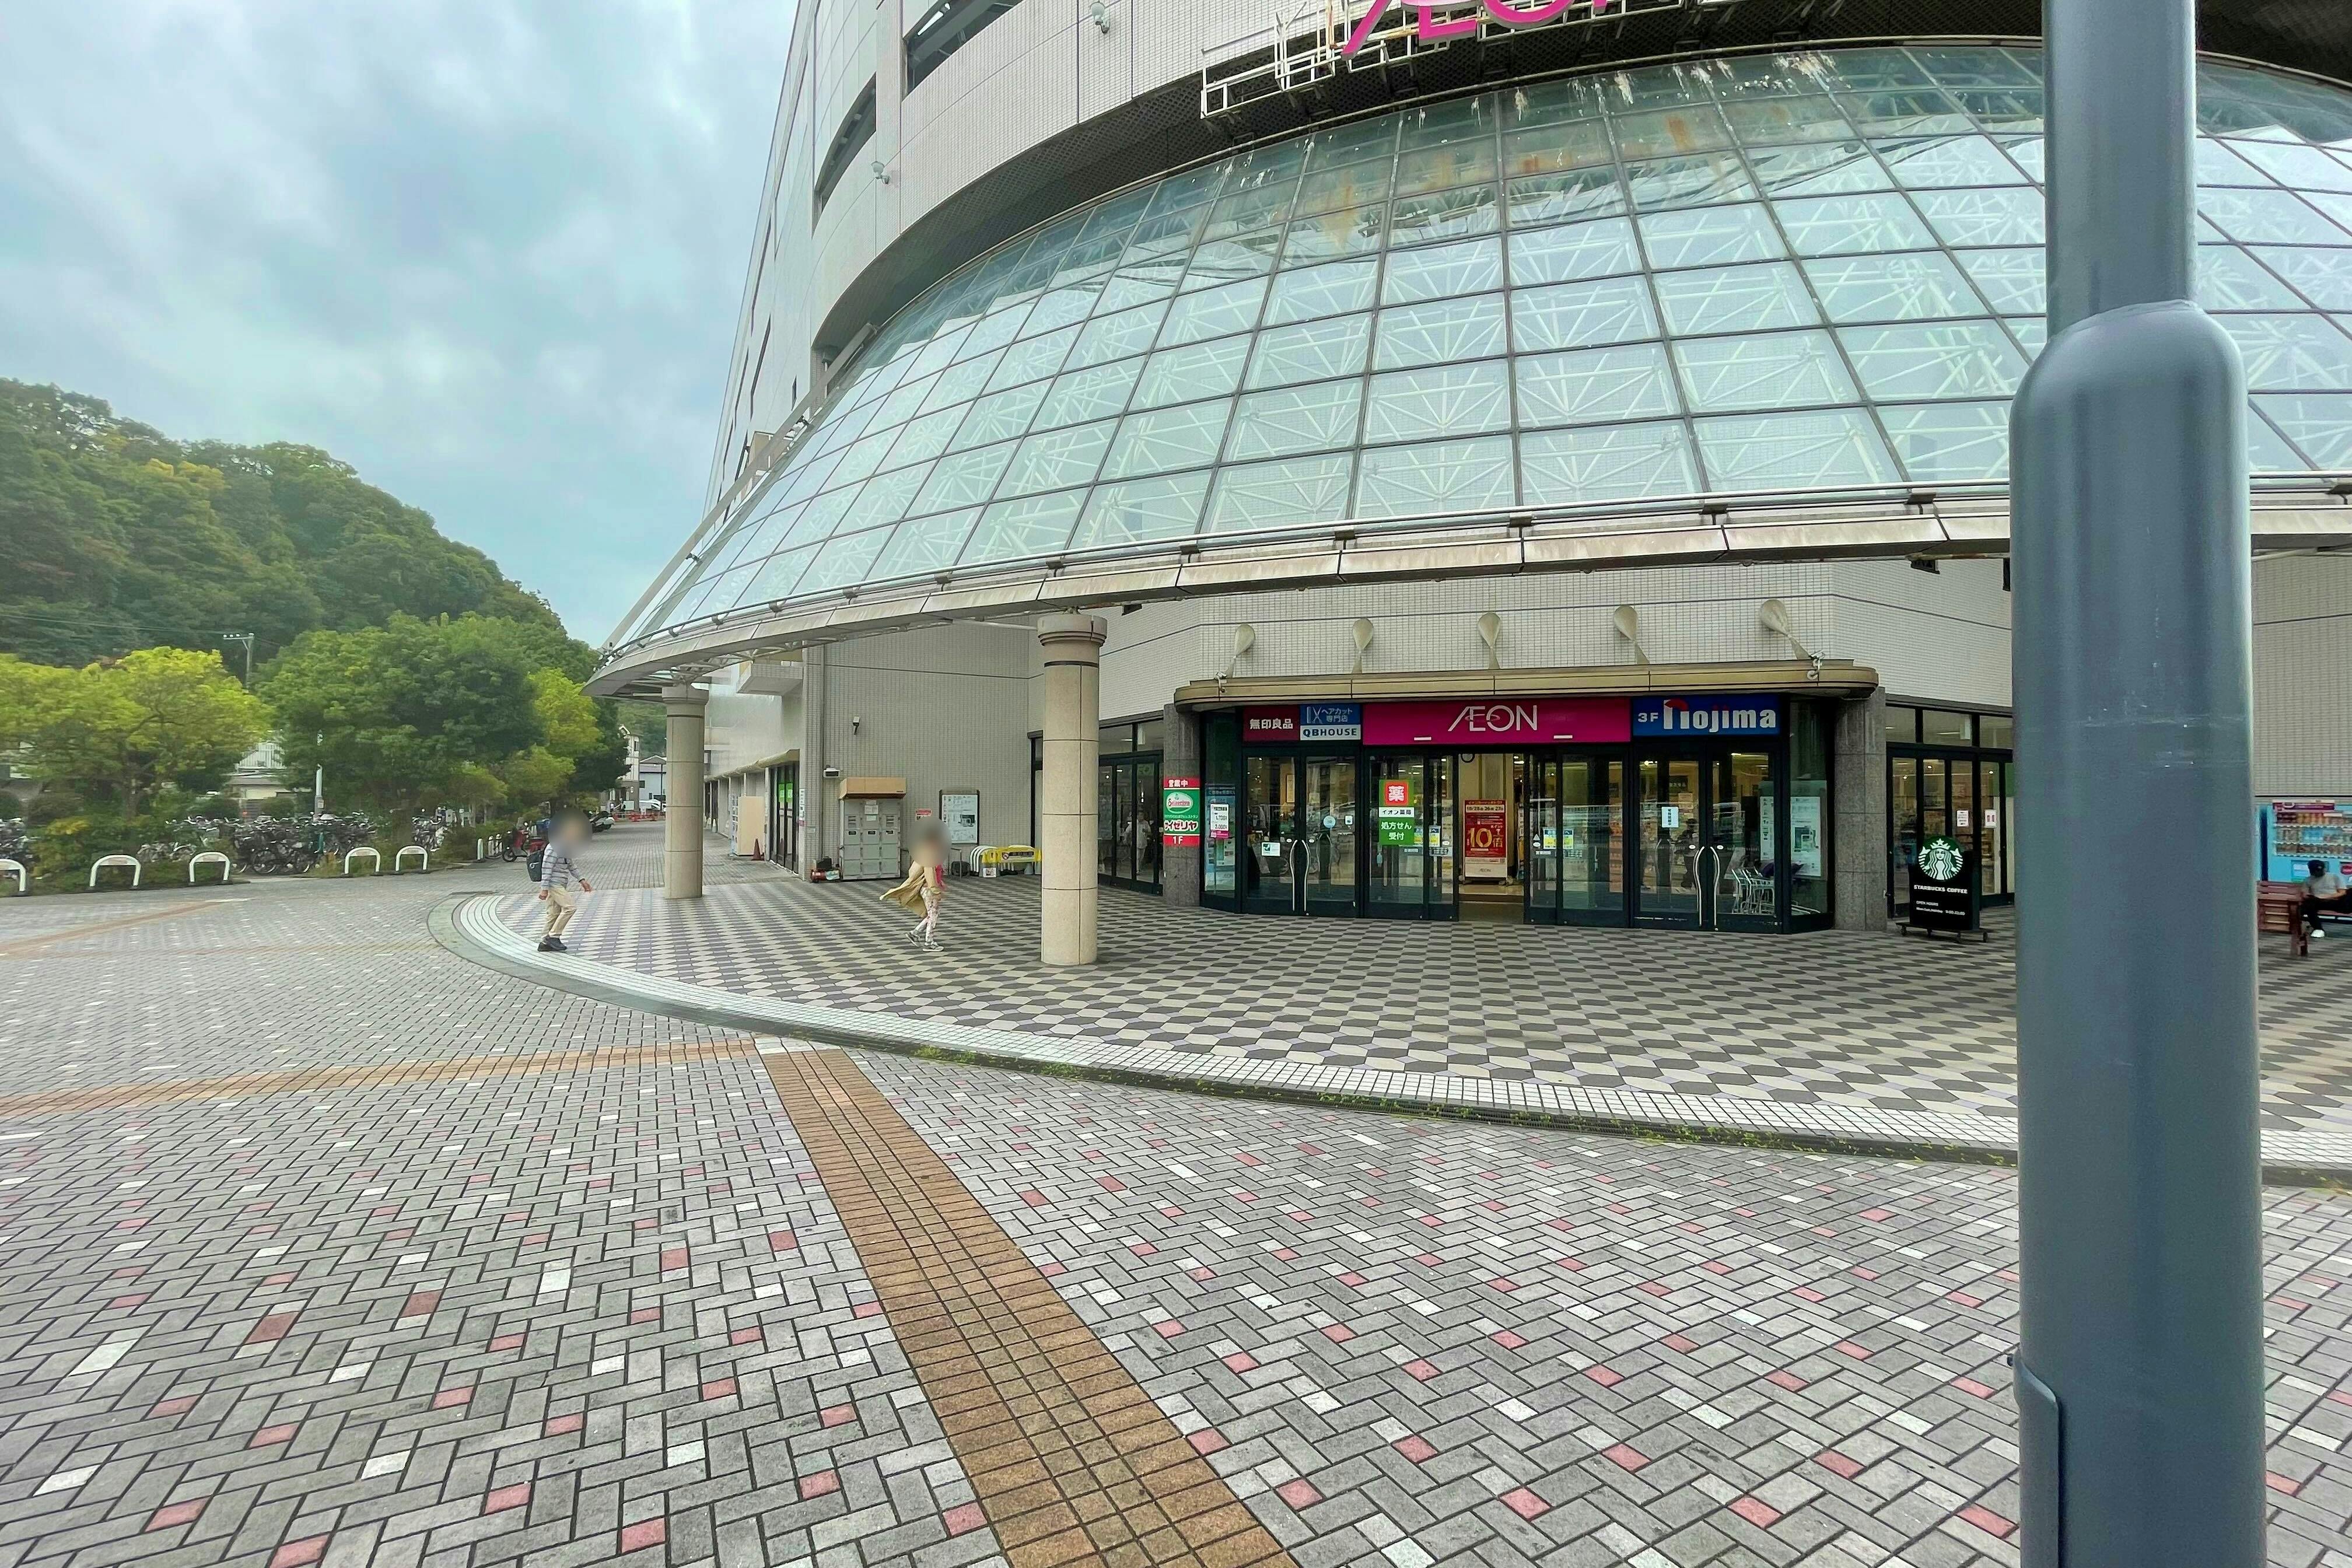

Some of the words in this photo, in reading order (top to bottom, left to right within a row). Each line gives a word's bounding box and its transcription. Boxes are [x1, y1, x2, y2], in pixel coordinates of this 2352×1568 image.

[1637, 712, 1659, 723] 3F
[1664, 698, 1776, 733] nojima
[1250, 718, 1294, 730] 無印良品
[1303, 728, 1357, 738] QBHOUSE
[1168, 779, 1188, 788] 営業中
[1388, 785, 1405, 802] 薬
[1381, 821, 1412, 830] 処方せん
[1172, 836, 1184, 845] 1F
[1388, 832, 1405, 841] 受付
